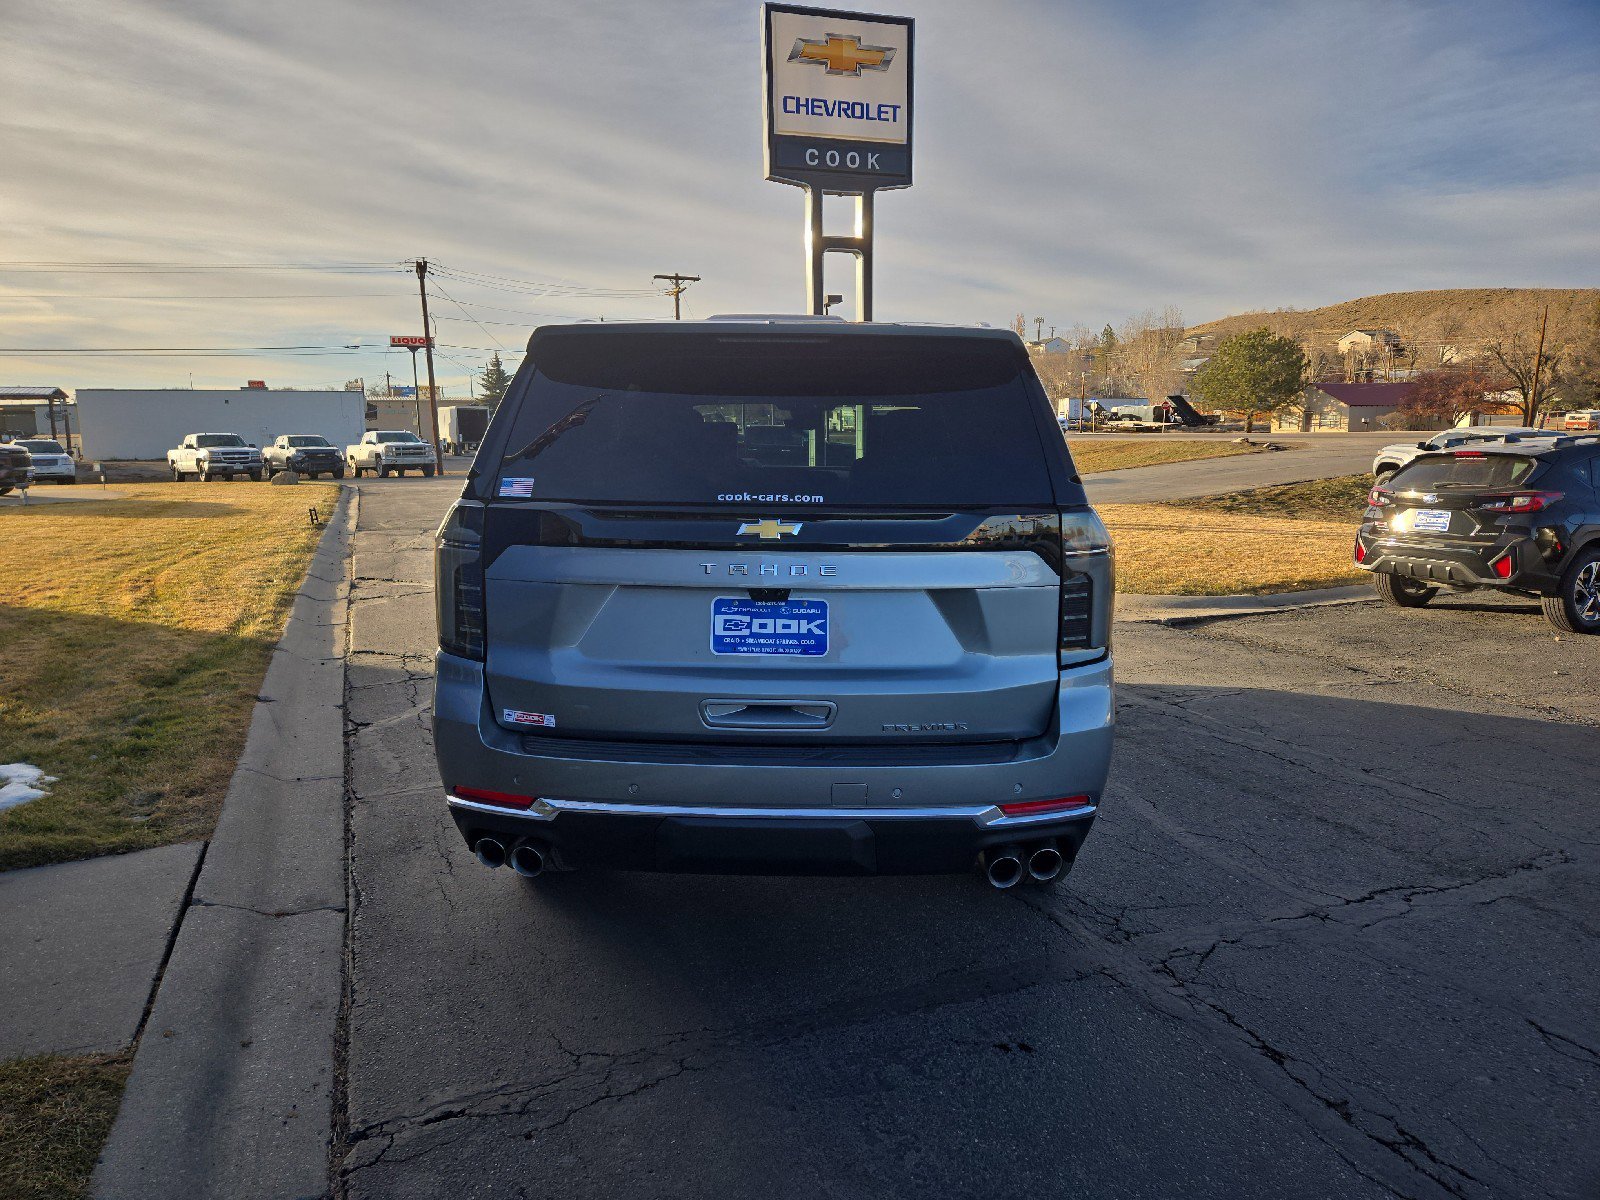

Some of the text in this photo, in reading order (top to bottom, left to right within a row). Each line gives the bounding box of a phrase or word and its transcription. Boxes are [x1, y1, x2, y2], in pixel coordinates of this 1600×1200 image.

[783, 95, 901, 122] CHEVROLET
[805, 148, 880, 170] COOK
[391, 337, 427, 345] LIQUO
[717, 492, 824, 503] cook-cars.com
[700, 563, 837, 576] TAHOE
[714, 614, 826, 635] COOK
[881, 722, 968, 733] PREMIER
